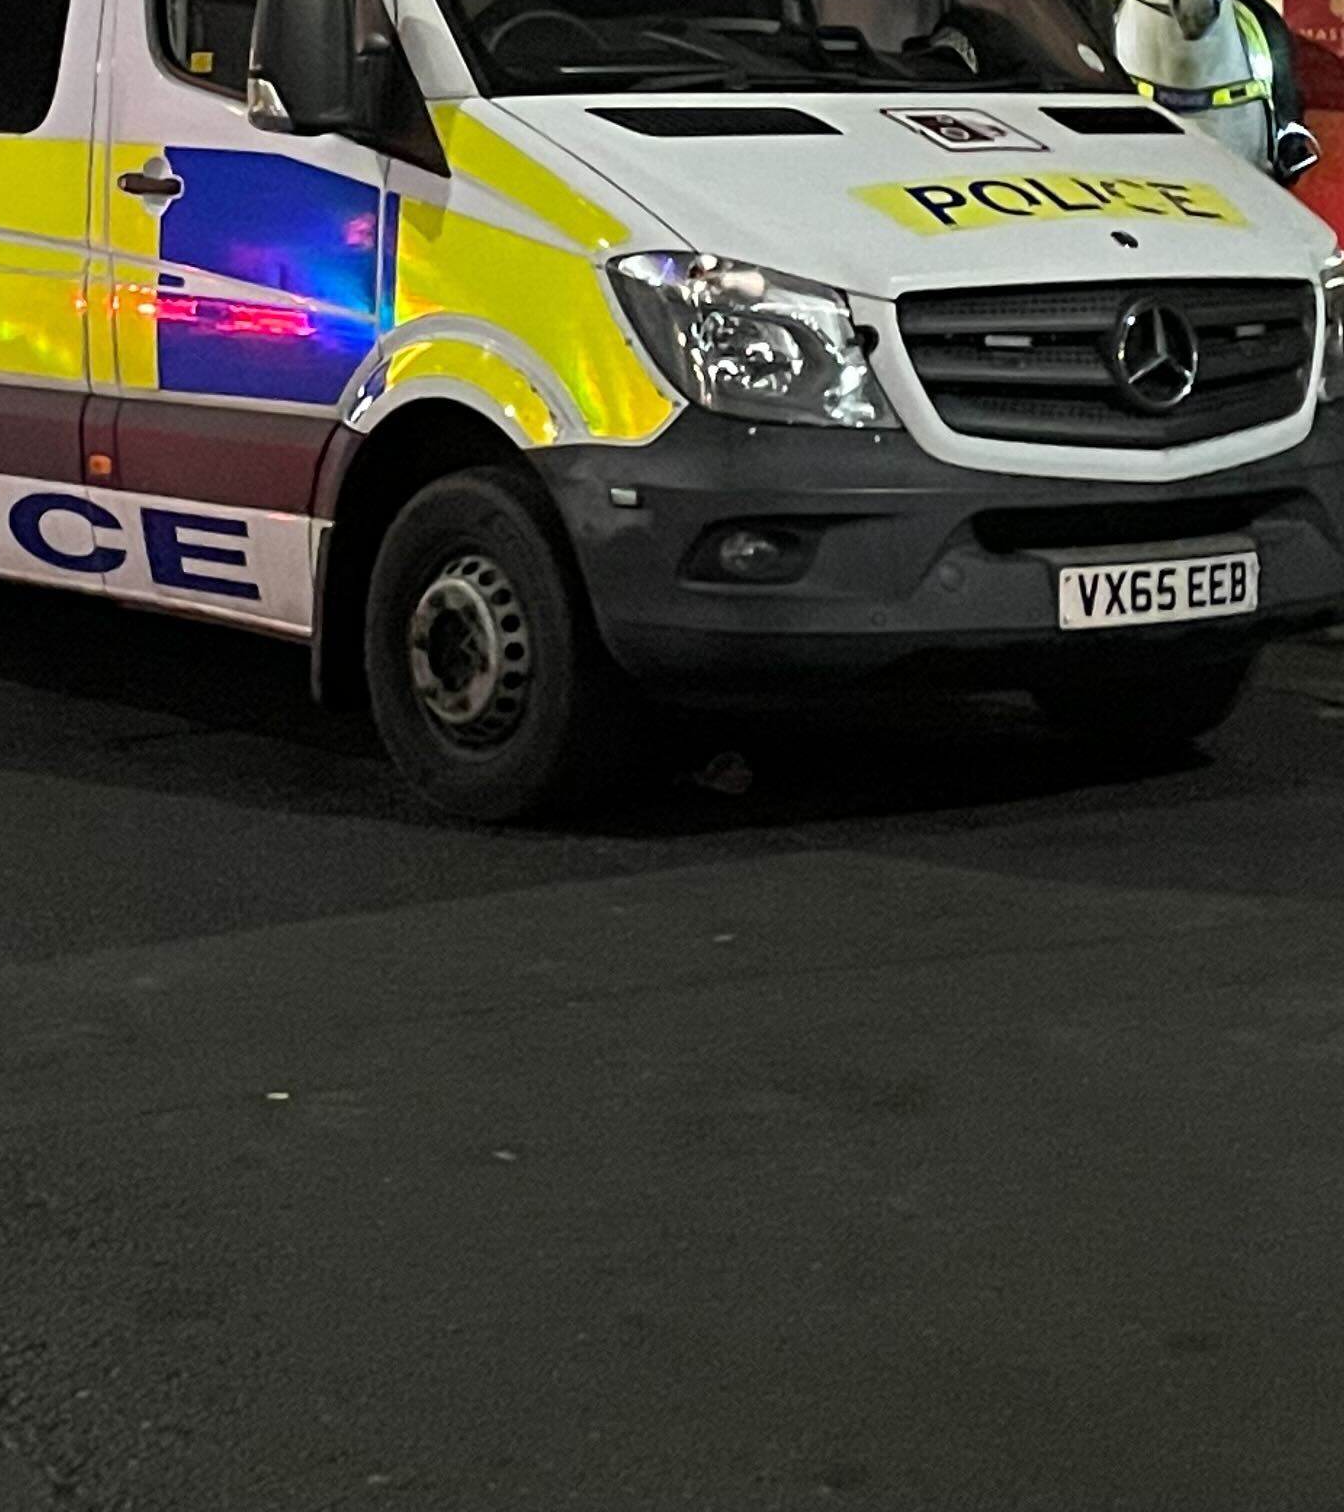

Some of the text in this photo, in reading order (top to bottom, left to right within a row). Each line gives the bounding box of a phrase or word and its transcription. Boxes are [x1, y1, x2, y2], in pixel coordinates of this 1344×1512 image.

[903, 177, 1223, 227] POLICE
[1077, 561, 1247, 617] VX65 EEB
